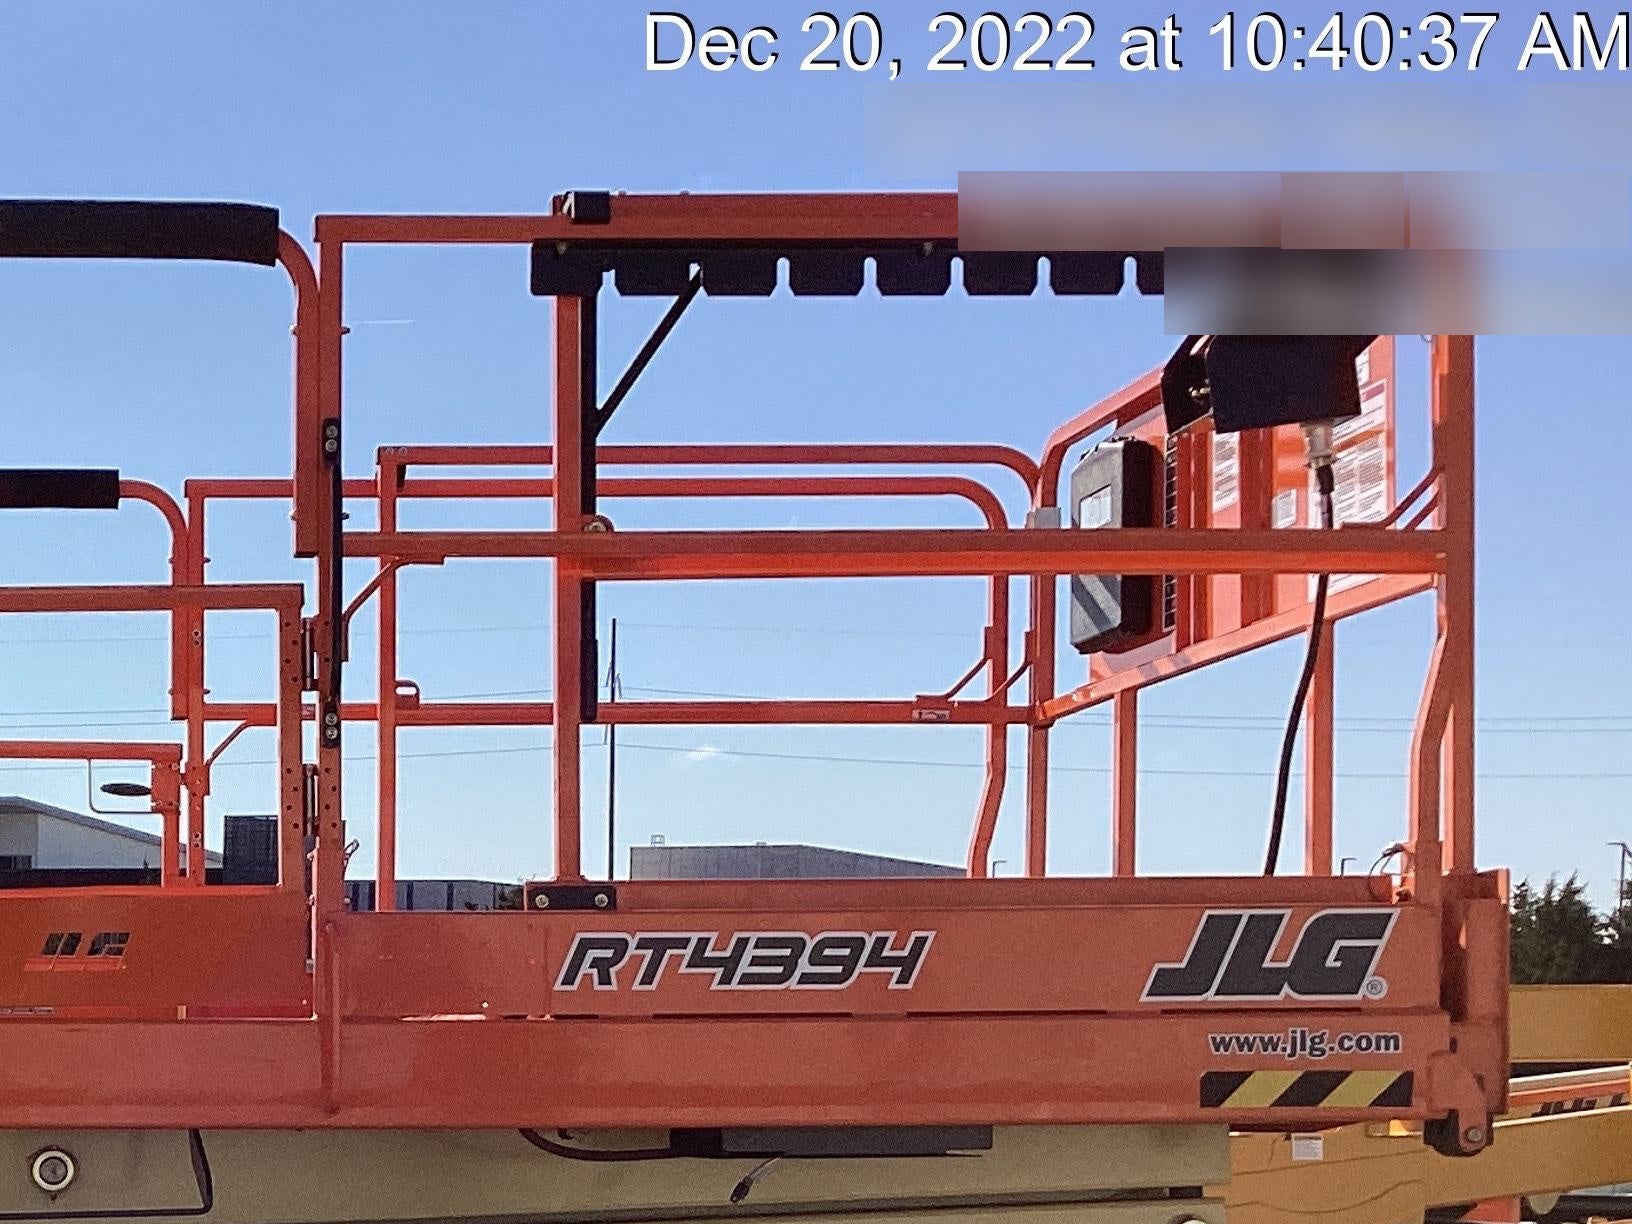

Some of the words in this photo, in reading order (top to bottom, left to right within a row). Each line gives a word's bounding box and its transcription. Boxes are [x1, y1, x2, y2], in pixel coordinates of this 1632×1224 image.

[553, 930, 937, 991] RT4394
[1137, 907, 1401, 1002] JLG
[1207, 1026, 1403, 1061] www.jlg.com
